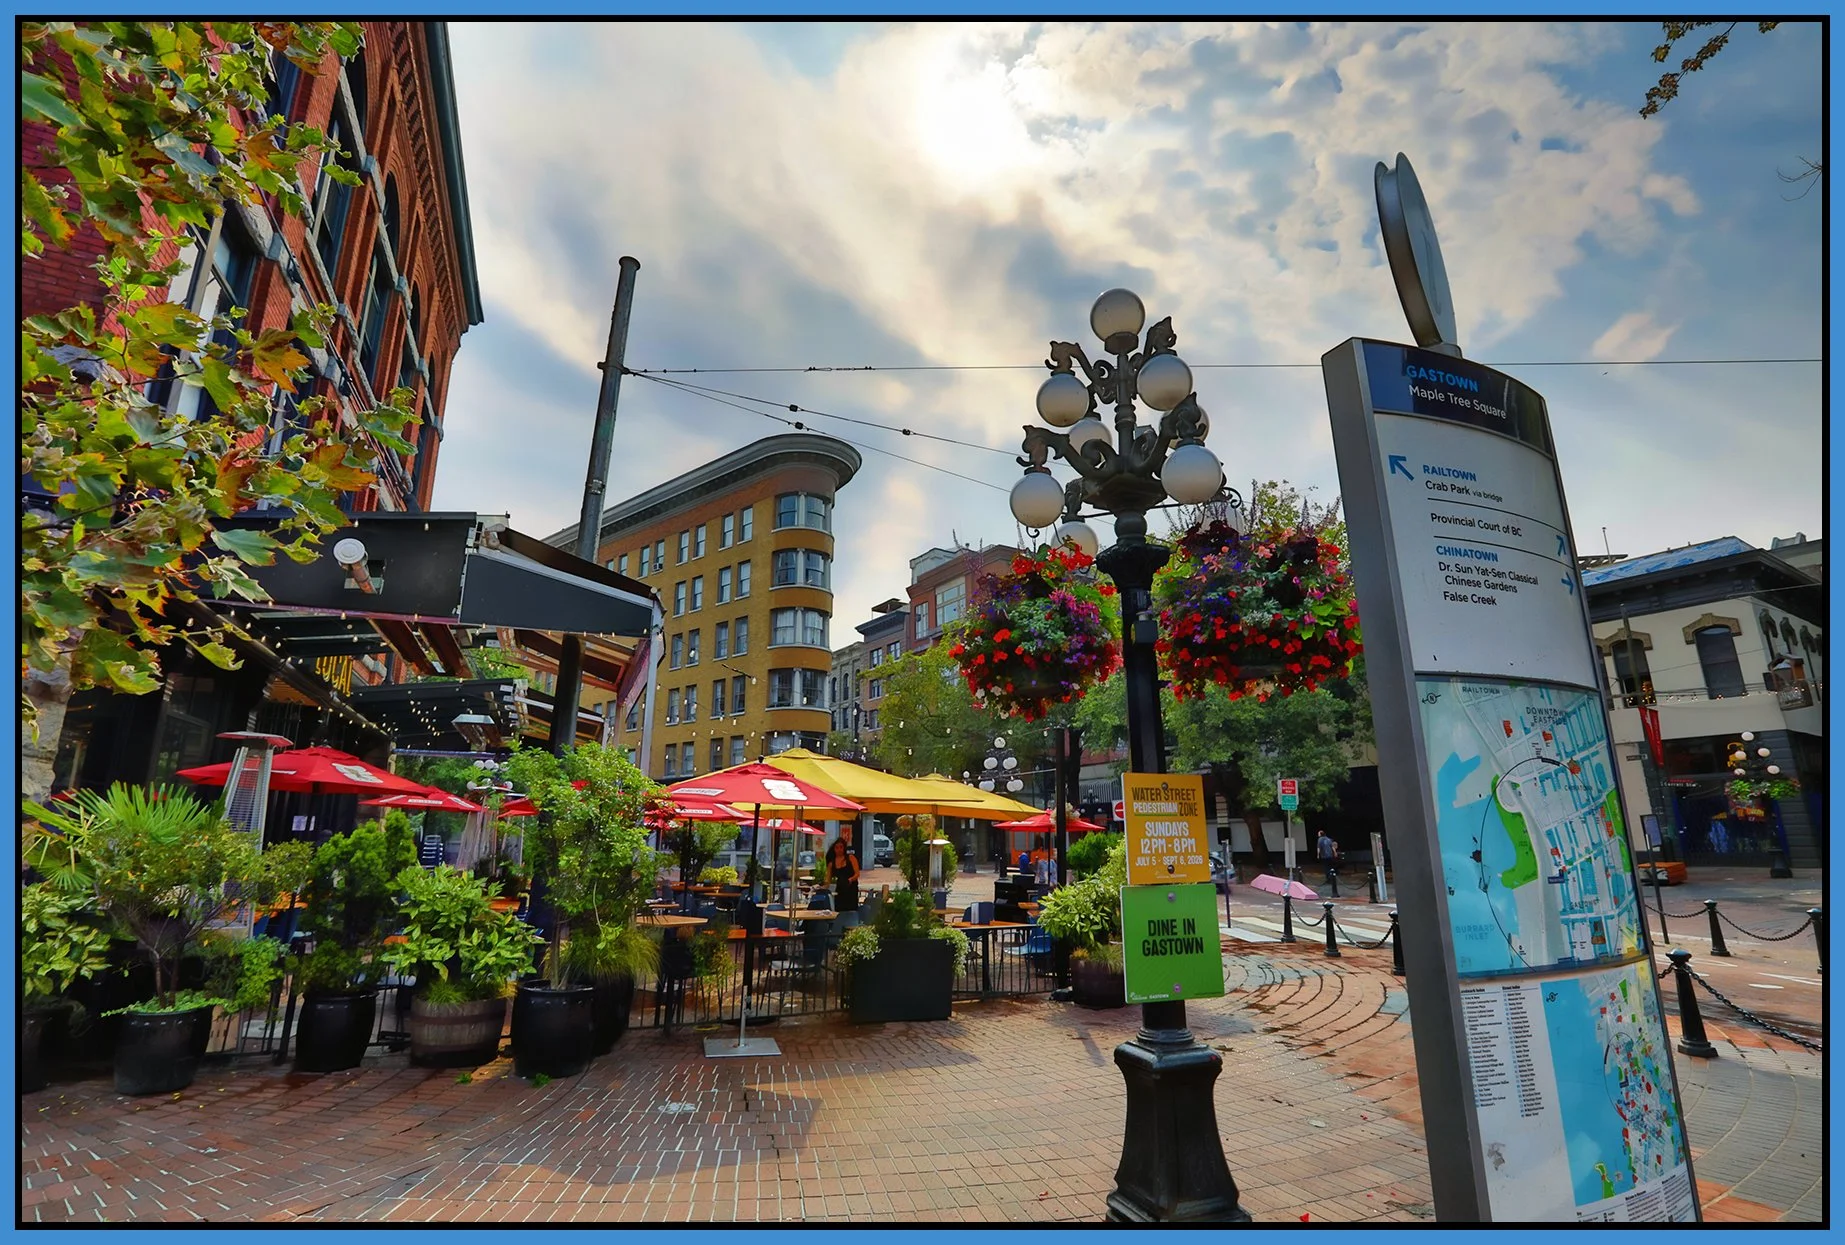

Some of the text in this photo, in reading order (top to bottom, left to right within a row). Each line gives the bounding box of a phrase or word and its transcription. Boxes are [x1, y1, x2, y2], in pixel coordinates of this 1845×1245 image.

[1406, 365, 1479, 393] GASTOWN
[1409, 384, 1507, 420] Maple Tree Square
[1423, 464, 1477, 482] RAILTOWN
[1425, 480, 1503, 503] Crab Park via bridge
[1430, 513, 1522, 537] Provincial Court of BC
[1436, 545, 1499, 563] CHINATOWN
[1438, 561, 1539, 586] Dr. Sun Yat-Sen Classical
[1444, 575, 1518, 594] Chinese Gardens
[1443, 591, 1497, 606] False Creek
[1462, 686, 1500, 695] RAILTOWN
[1131, 787, 1196, 802] WATER STREET
[1133, 802, 1198, 817] PEDESTRIAN ZONE
[1145, 821, 1189, 837] SUNDAYS
[1140, 838, 1150, 854] 12
[1151, 838, 1167, 854] PM
[1135, 855, 1151, 867] JULY
[1152, 855, 1157, 866] 5
[1162, 855, 1178, 866] SEPT
[1148, 917, 1196, 937] DINE IN
[1142, 937, 1204, 957] GASTOWN
